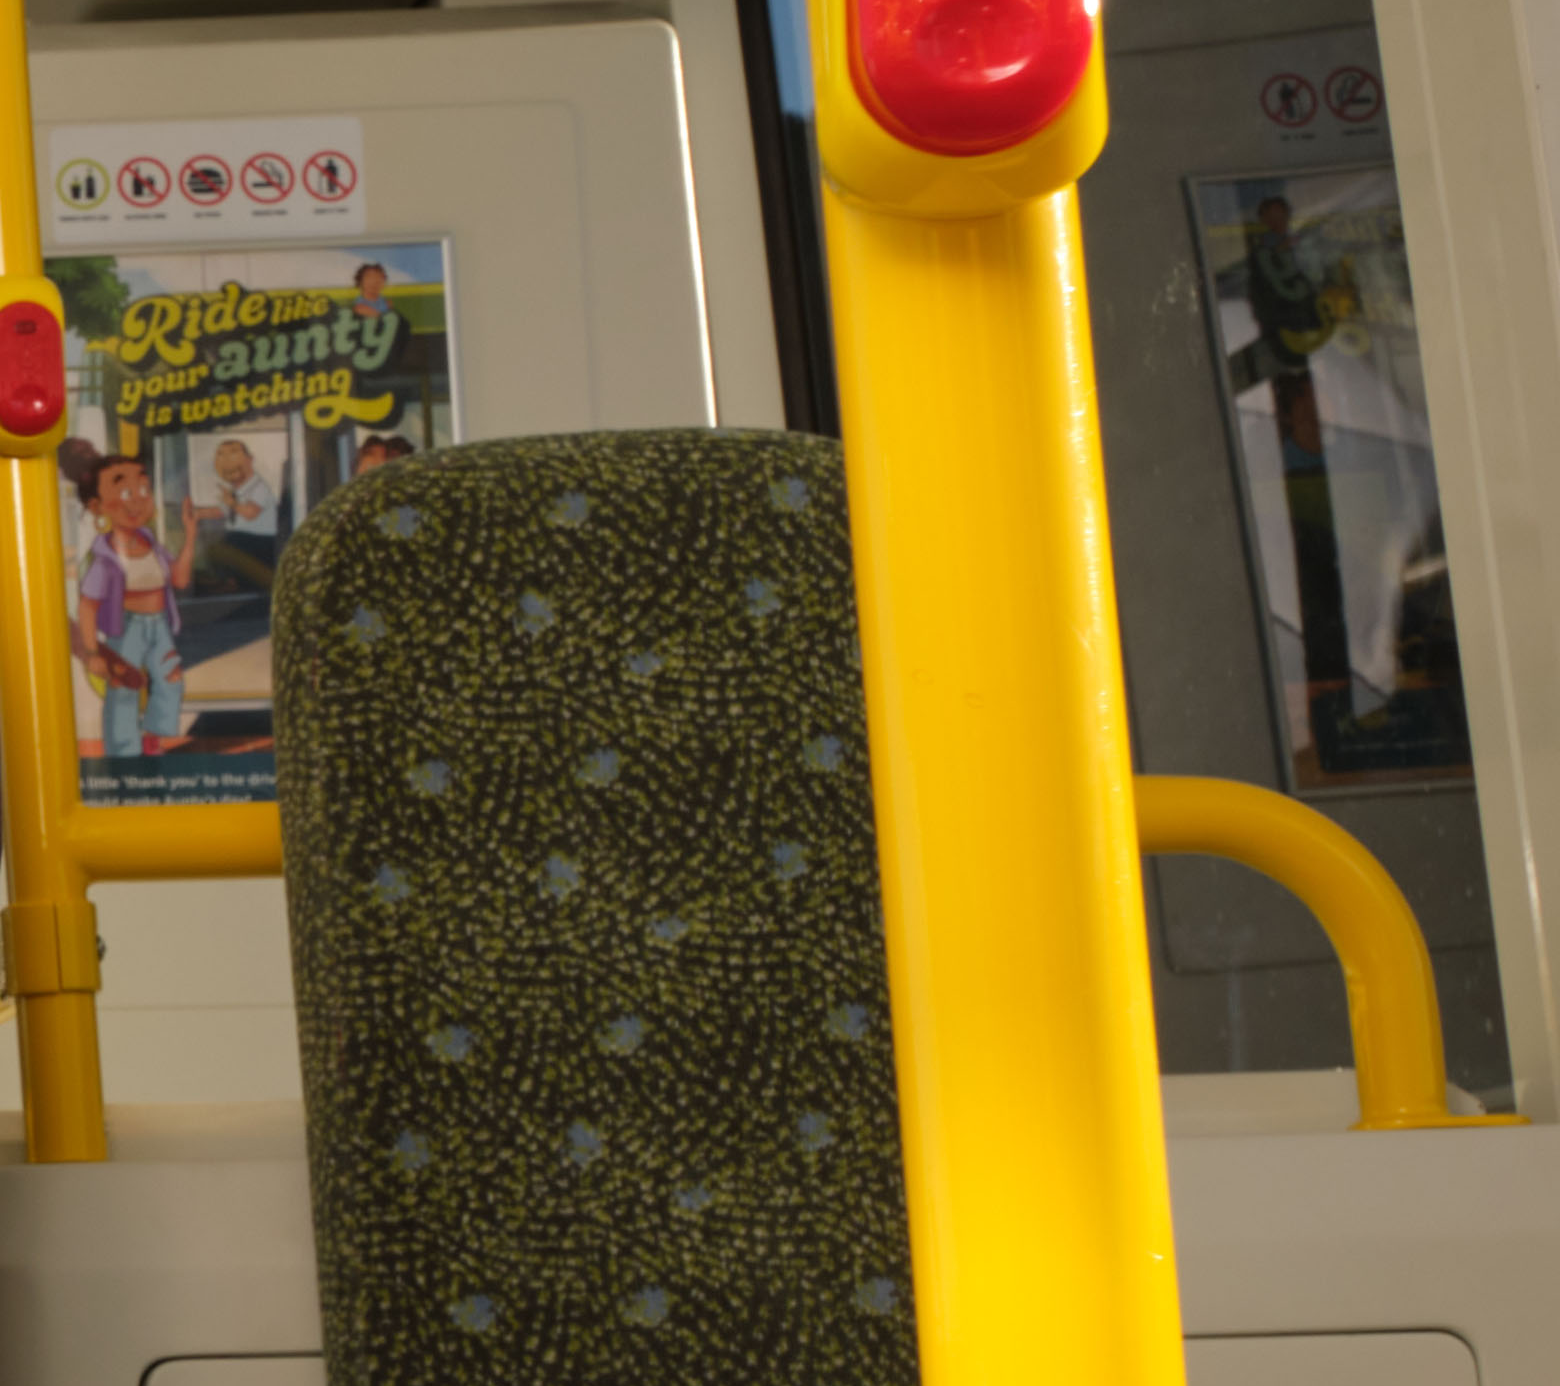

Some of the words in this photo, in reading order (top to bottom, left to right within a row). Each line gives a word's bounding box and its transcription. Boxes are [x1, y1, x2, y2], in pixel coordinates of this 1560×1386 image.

[120, 281, 267, 366] Ride
[271, 294, 330, 325] like
[116, 363, 210, 415] your
[214, 307, 399, 381] aunty
[145, 402, 173, 428] is
[180, 368, 394, 430] watching
[203, 774, 219, 787] to
[221, 773, 246, 787] the
